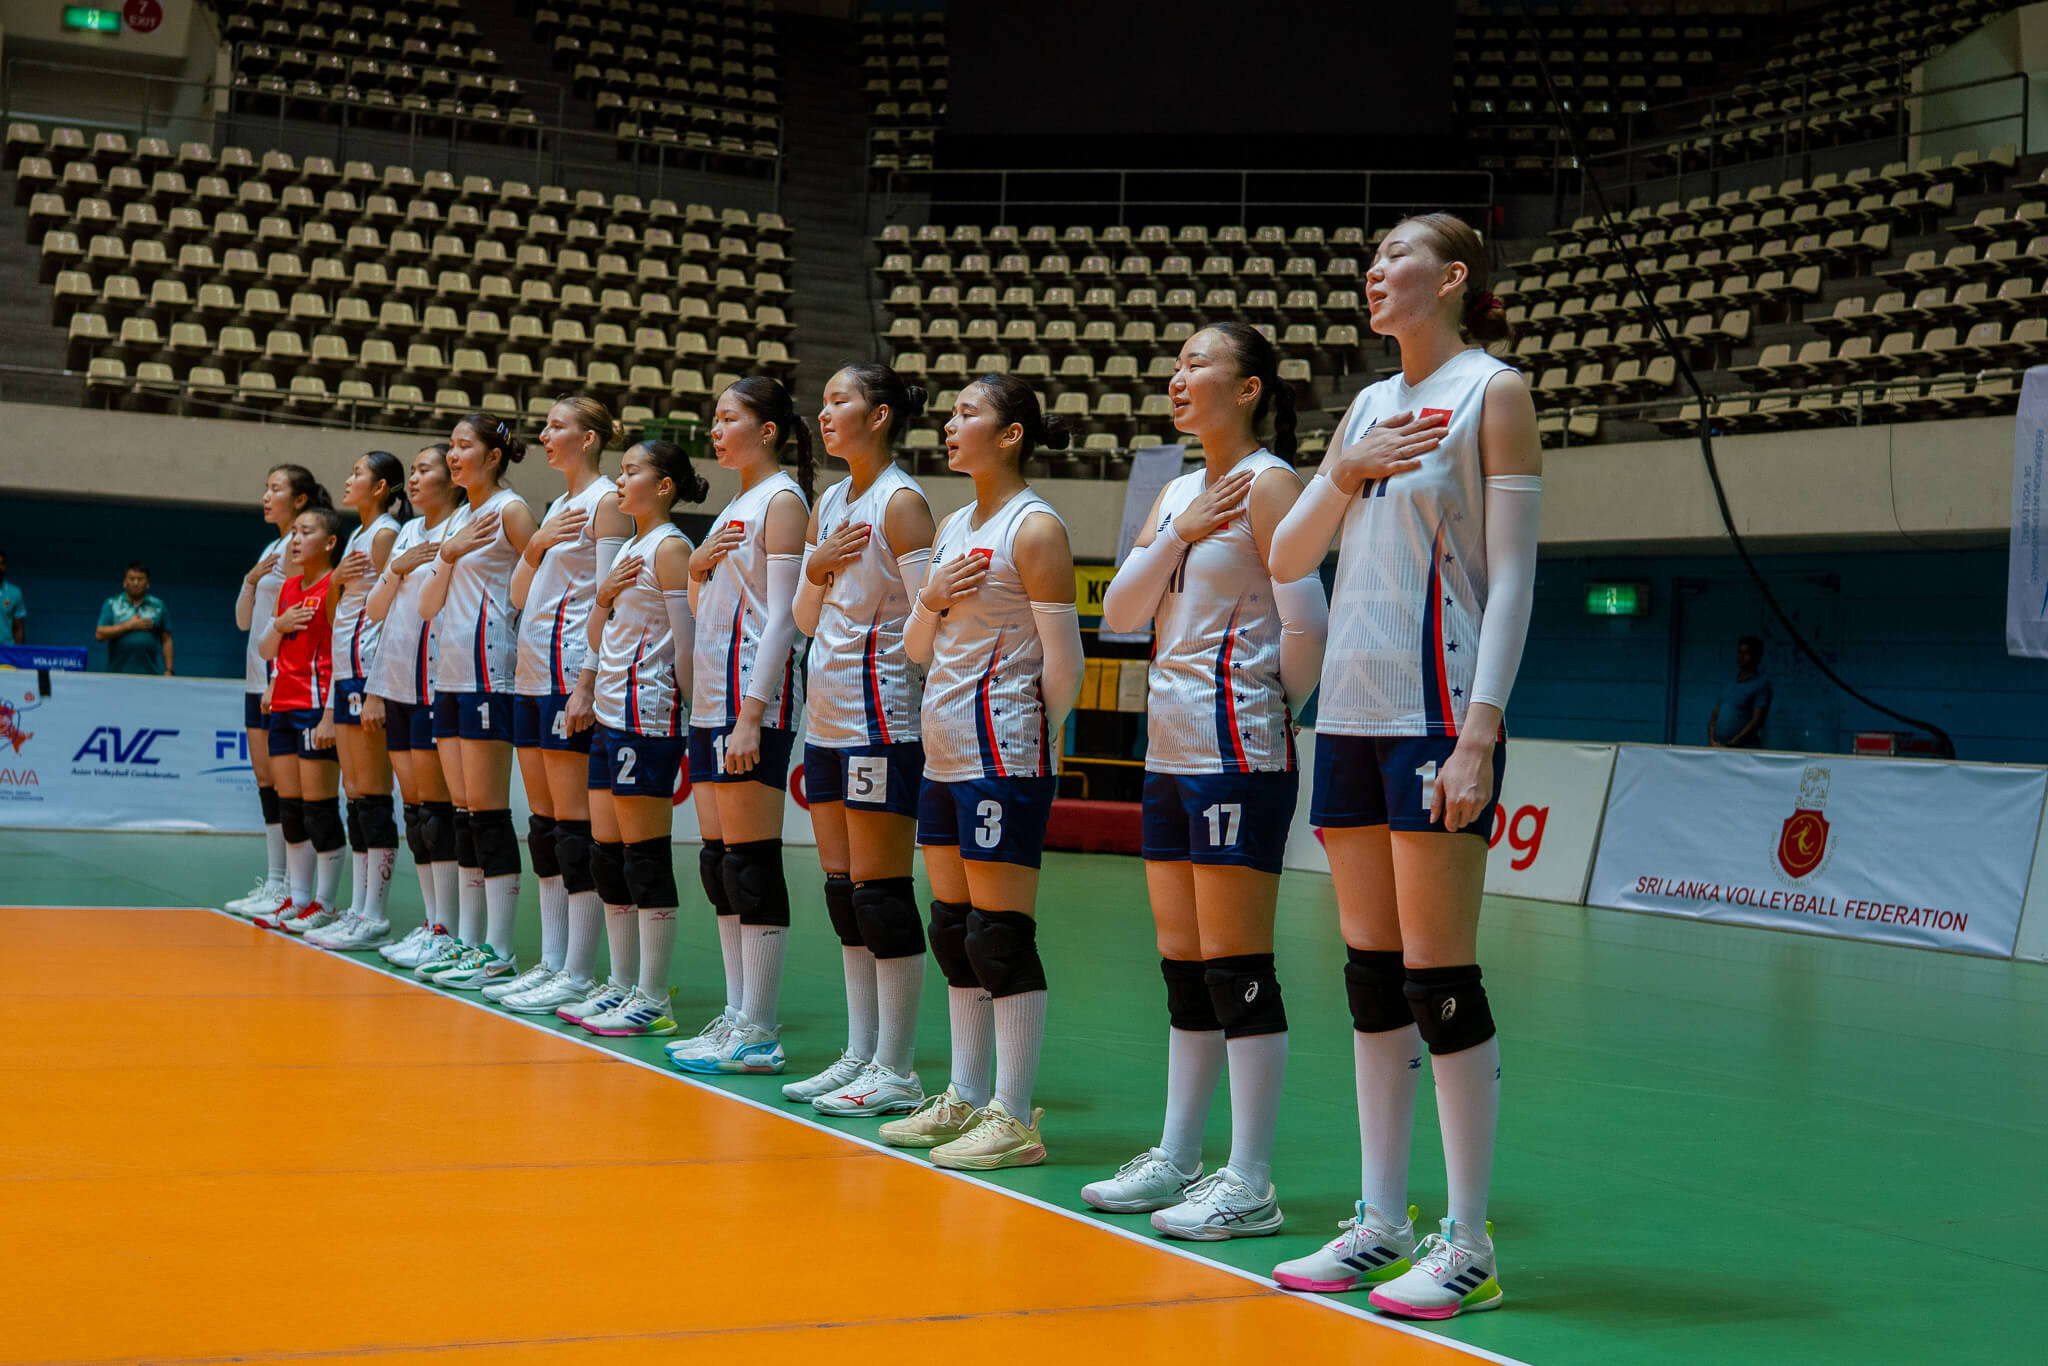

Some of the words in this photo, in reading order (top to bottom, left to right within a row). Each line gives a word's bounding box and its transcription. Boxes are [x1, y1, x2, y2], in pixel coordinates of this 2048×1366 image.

[129, 14, 158, 27] EXIT
[137, 1, 149, 14] 7
[477, 702, 490, 729] 1
[72, 726, 179, 764] AVC
[616, 746, 637, 784] 2
[855, 767, 873, 795] 5
[975, 800, 1003, 848] 3
[1203, 803, 1242, 846] 17
[1636, 876, 1663, 897] SRI
[1665, 879, 1720, 903] LANKA
[1726, 887, 1838, 917] VOLLEYBALL
[1844, 899, 1969, 932] FEDERATION
